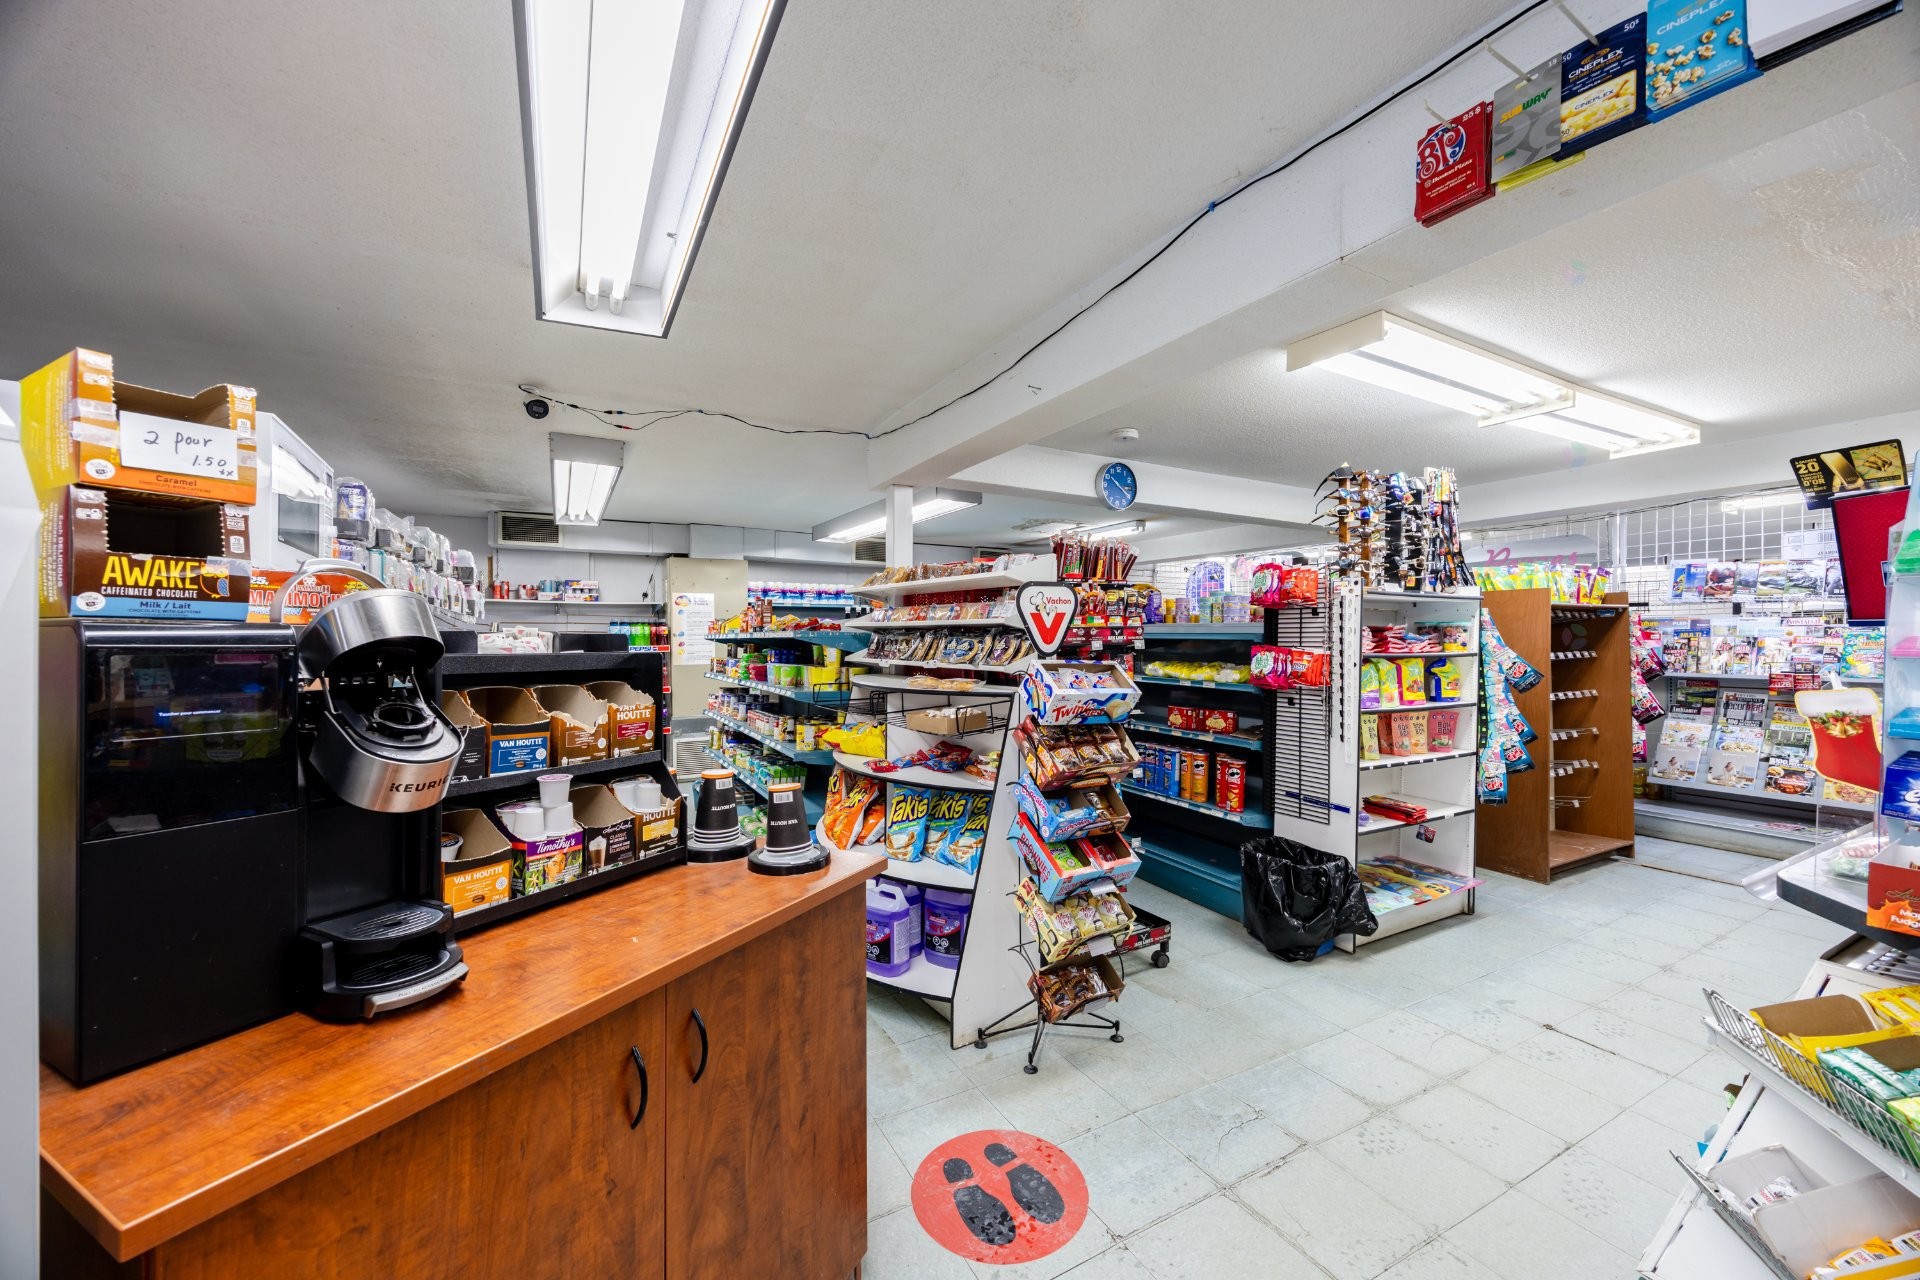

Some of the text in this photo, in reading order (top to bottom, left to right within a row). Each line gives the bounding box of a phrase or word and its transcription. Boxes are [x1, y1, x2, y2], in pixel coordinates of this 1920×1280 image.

[1568, 47, 1624, 79] CINEPLEX
[1499, 86, 1552, 124] SUBWAY
[1574, 89, 1614, 110] CINEPLEX
[1432, 159, 1472, 183] Boston Pizza
[143, 431, 213, 454] 2 pour
[192, 455, 227, 467] 1.50
[1797, 461, 1820, 474] 20
[156, 475, 197, 486] Caramel
[1803, 479, 1826, 487] D'OR
[102, 555, 200, 589] AWAKE
[101, 586, 198, 599] CAFFEINATED CHOCOLATE
[1046, 596, 1072, 605] Vachon
[139, 601, 162, 609] Milk
[617, 709, 652, 720] HOUTTE
[1052, 700, 1106, 722] Twinkies
[499, 738, 543, 748] VAN HOUTTE
[643, 806, 677, 822] HOUTTE
[888, 794, 930, 829] Takis
[536, 836, 576, 854] Timothy's
[454, 865, 504, 885] VAN HOUTTE
[1891, 915, 1920, 929] Fudg
